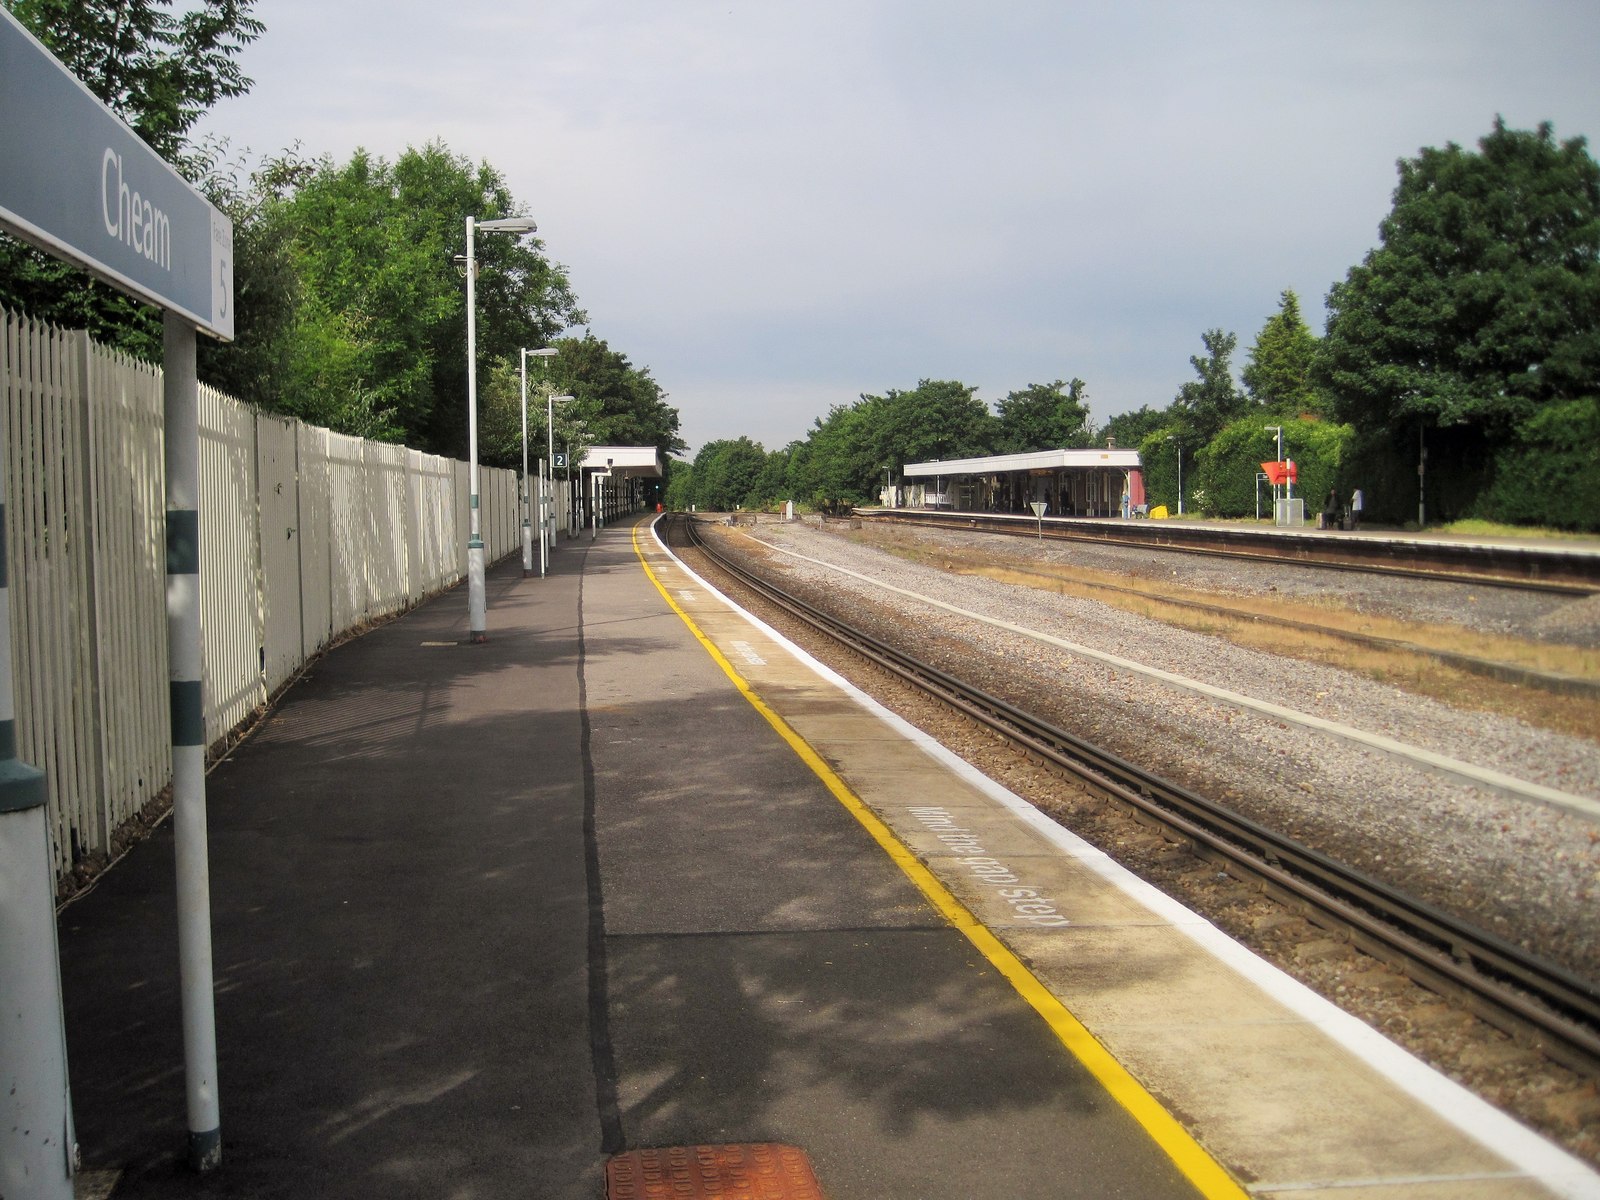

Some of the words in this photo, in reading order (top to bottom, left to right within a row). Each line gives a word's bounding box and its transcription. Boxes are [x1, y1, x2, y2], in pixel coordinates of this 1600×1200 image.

[103, 147, 170, 271] Cheam
[219, 258, 227, 319] 5
[556, 455, 563, 465] 2
[905, 806, 970, 832] Mind
[936, 834, 986, 852] the
